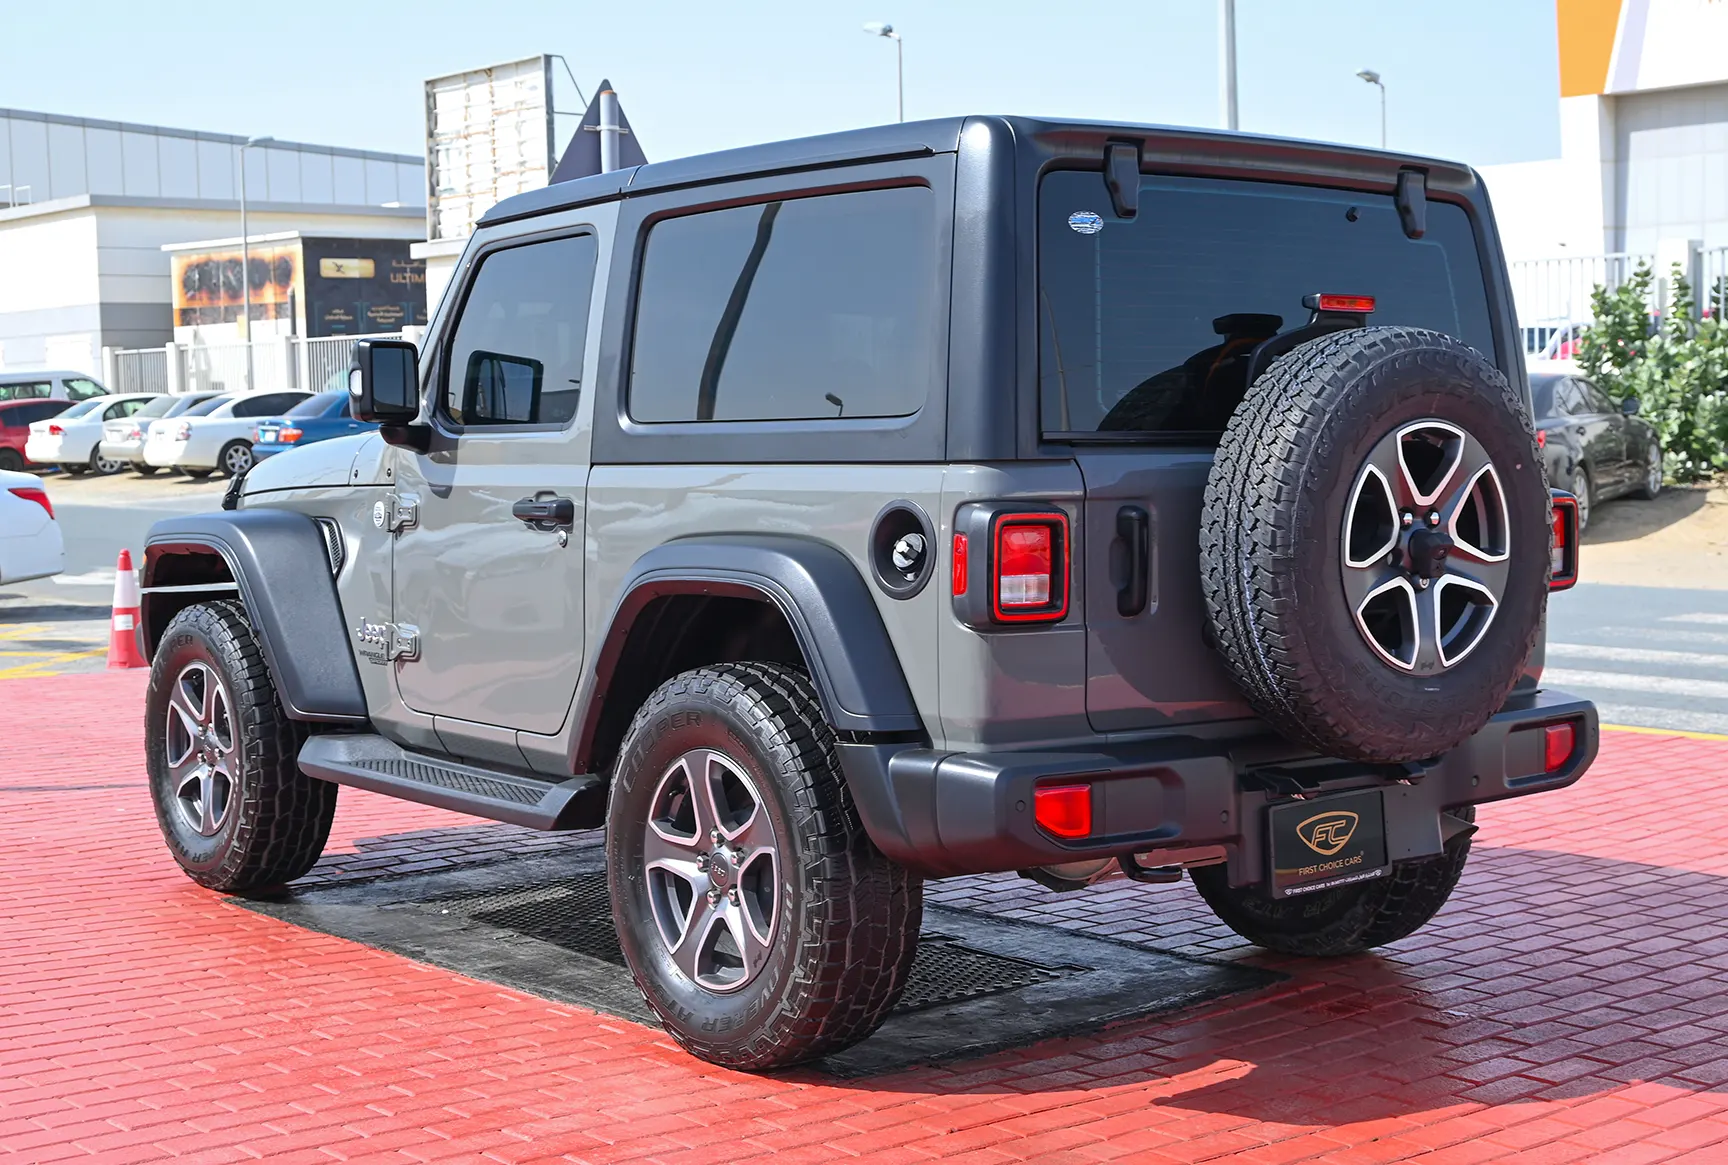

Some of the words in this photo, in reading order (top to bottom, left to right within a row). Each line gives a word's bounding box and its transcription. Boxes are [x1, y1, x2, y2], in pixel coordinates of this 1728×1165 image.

[356, 616, 386, 650] Jeep
[622, 710, 703, 793] COOPER
[1298, 864, 1319, 876] FIRST
[1318, 857, 1344, 873] CHOICE
[1344, 854, 1362, 867] CARS
